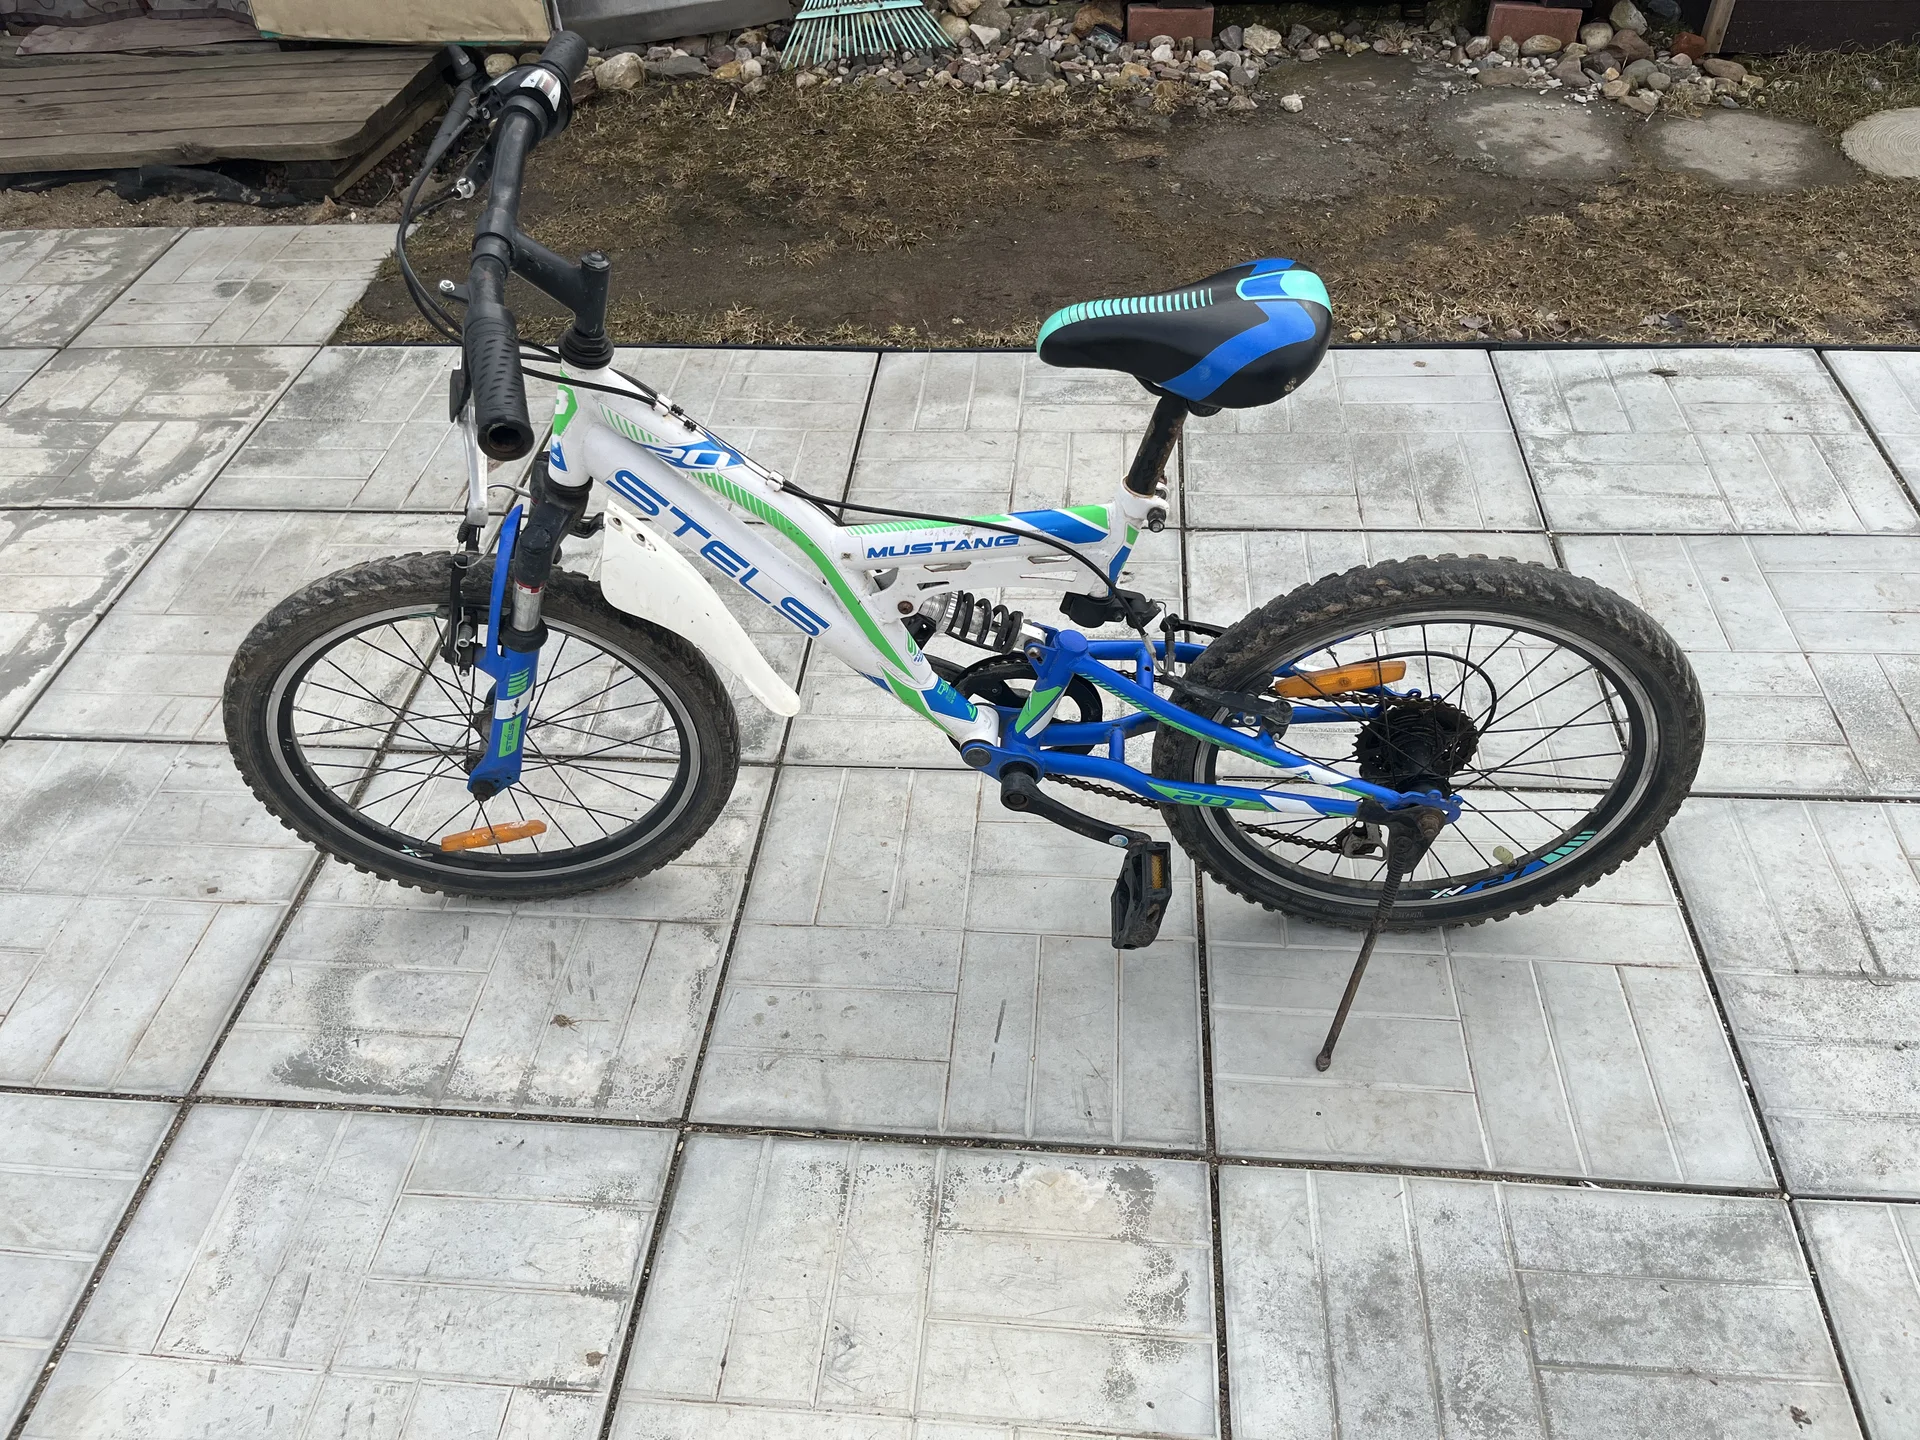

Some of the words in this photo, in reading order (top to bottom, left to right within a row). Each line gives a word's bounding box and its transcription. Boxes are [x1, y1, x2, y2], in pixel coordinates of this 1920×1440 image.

[605, 469, 830, 637] STELS
[867, 535, 1020, 559] MUSTANG
[1173, 790, 1234, 807] 20
